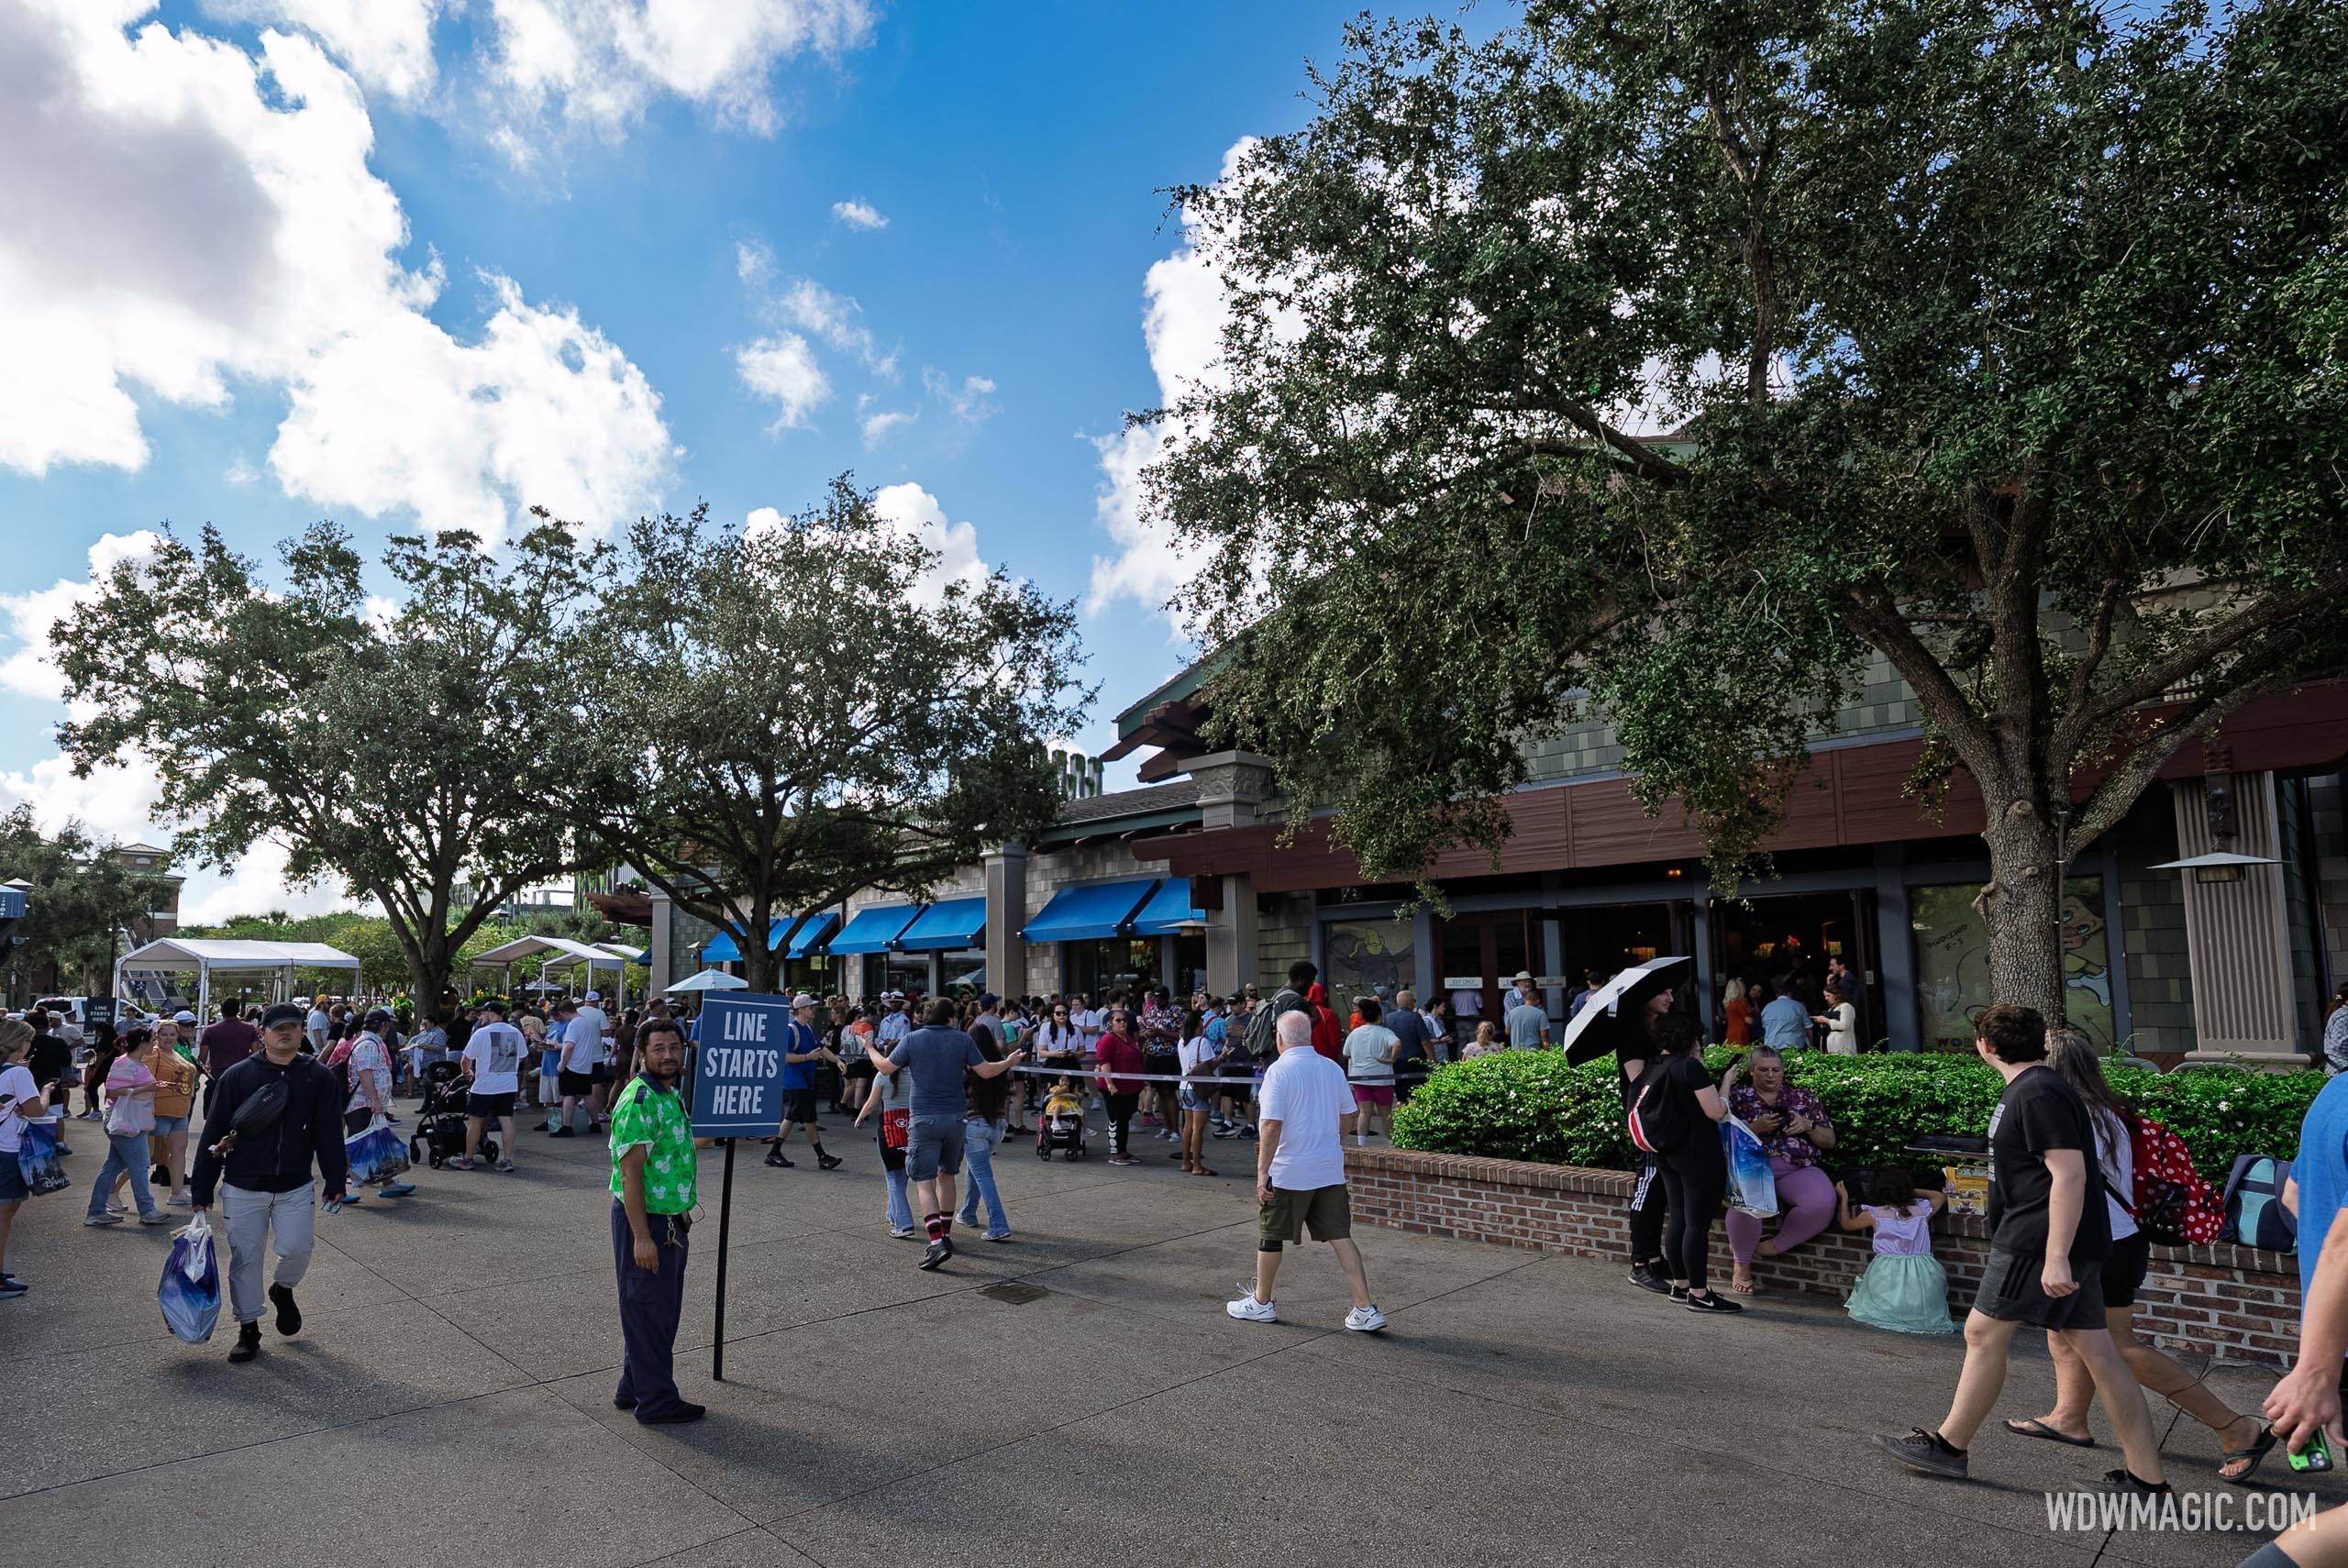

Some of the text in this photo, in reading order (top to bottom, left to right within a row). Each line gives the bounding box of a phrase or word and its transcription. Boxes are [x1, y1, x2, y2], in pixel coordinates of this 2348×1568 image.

[1926, 924, 1967, 949] PINOCCHIO
[724, 1011, 768, 1042] LINE
[704, 1047, 779, 1078] STARTS
[712, 1086, 765, 1115] HERE
